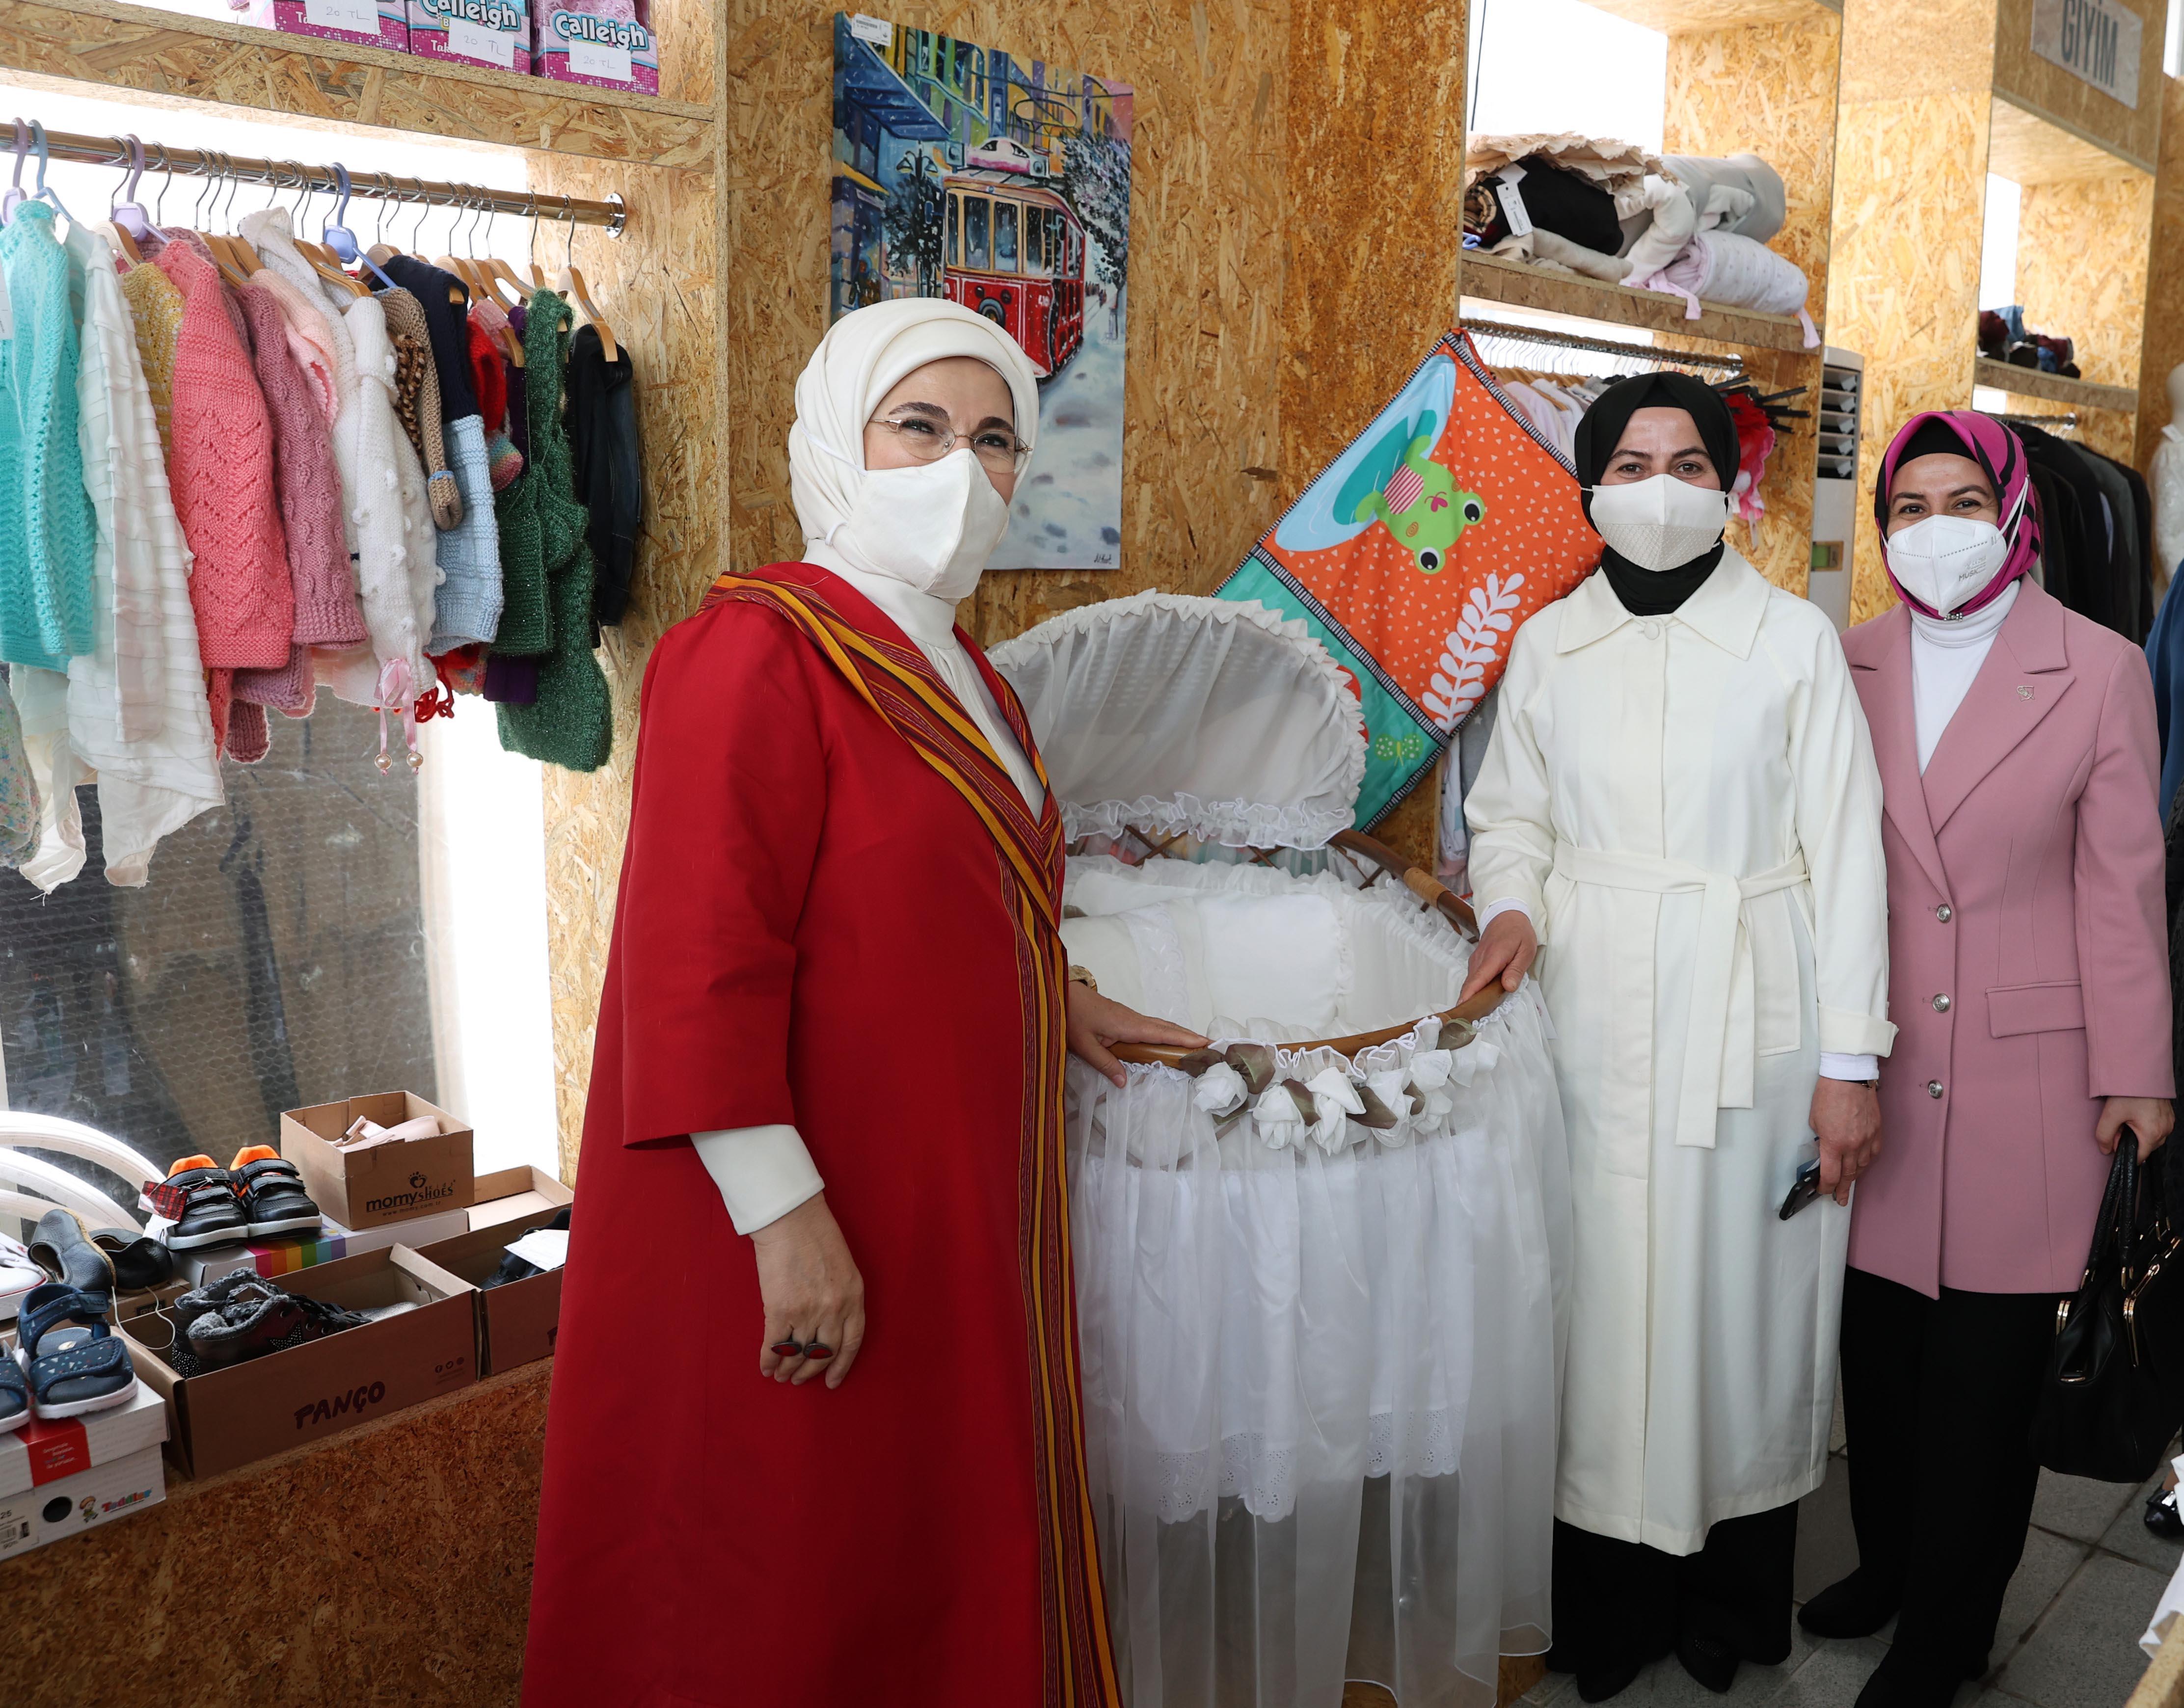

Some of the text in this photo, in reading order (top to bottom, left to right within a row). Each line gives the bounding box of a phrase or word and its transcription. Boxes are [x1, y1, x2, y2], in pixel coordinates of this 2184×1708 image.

[325, 6, 370, 21] 20 TL
[424, 0, 518, 30] Calleigh
[555, 14, 647, 50] Calleigh
[431, 39, 456, 54] Tak
[464, 35, 507, 57] 20 TL
[583, 55, 616, 69] 20 TL
[1959, 569, 1978, 582] MUSK
[294, 1381, 386, 1430] PANÇO
